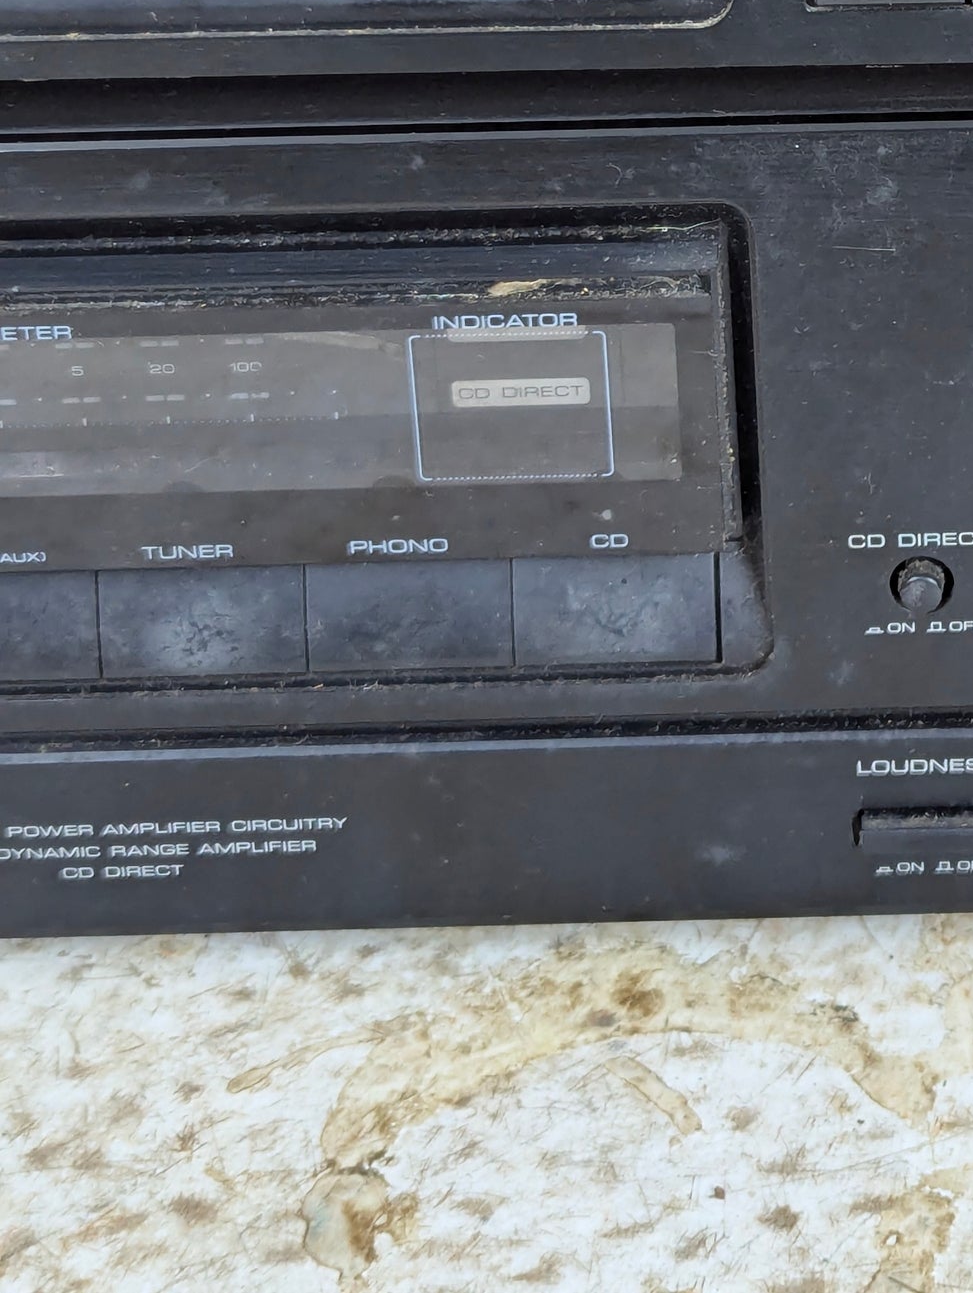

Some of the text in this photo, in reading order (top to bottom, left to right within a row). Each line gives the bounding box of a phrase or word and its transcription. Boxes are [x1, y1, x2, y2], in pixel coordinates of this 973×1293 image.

[434, 313, 577, 329] INDICATOR
[71, 365, 84, 377] 5
[149, 363, 176, 374] 20
[229, 361, 262, 373] 100
[457, 386, 582, 400] CD DIRECT
[349, 539, 448, 553] PHONO
[591, 534, 628, 548] CD
[848, 534, 885, 548] CD
[141, 545, 233, 559] TUNER
[887, 621, 916, 634] ON
[7, 818, 347, 837] POWER AMPLIFIER CIRCUITRY
[0, 840, 316, 859] DYNAMIC RANGE AMPLIFIER
[61, 865, 184, 879] CD DIRECT
[895, 861, 925, 874] ON
